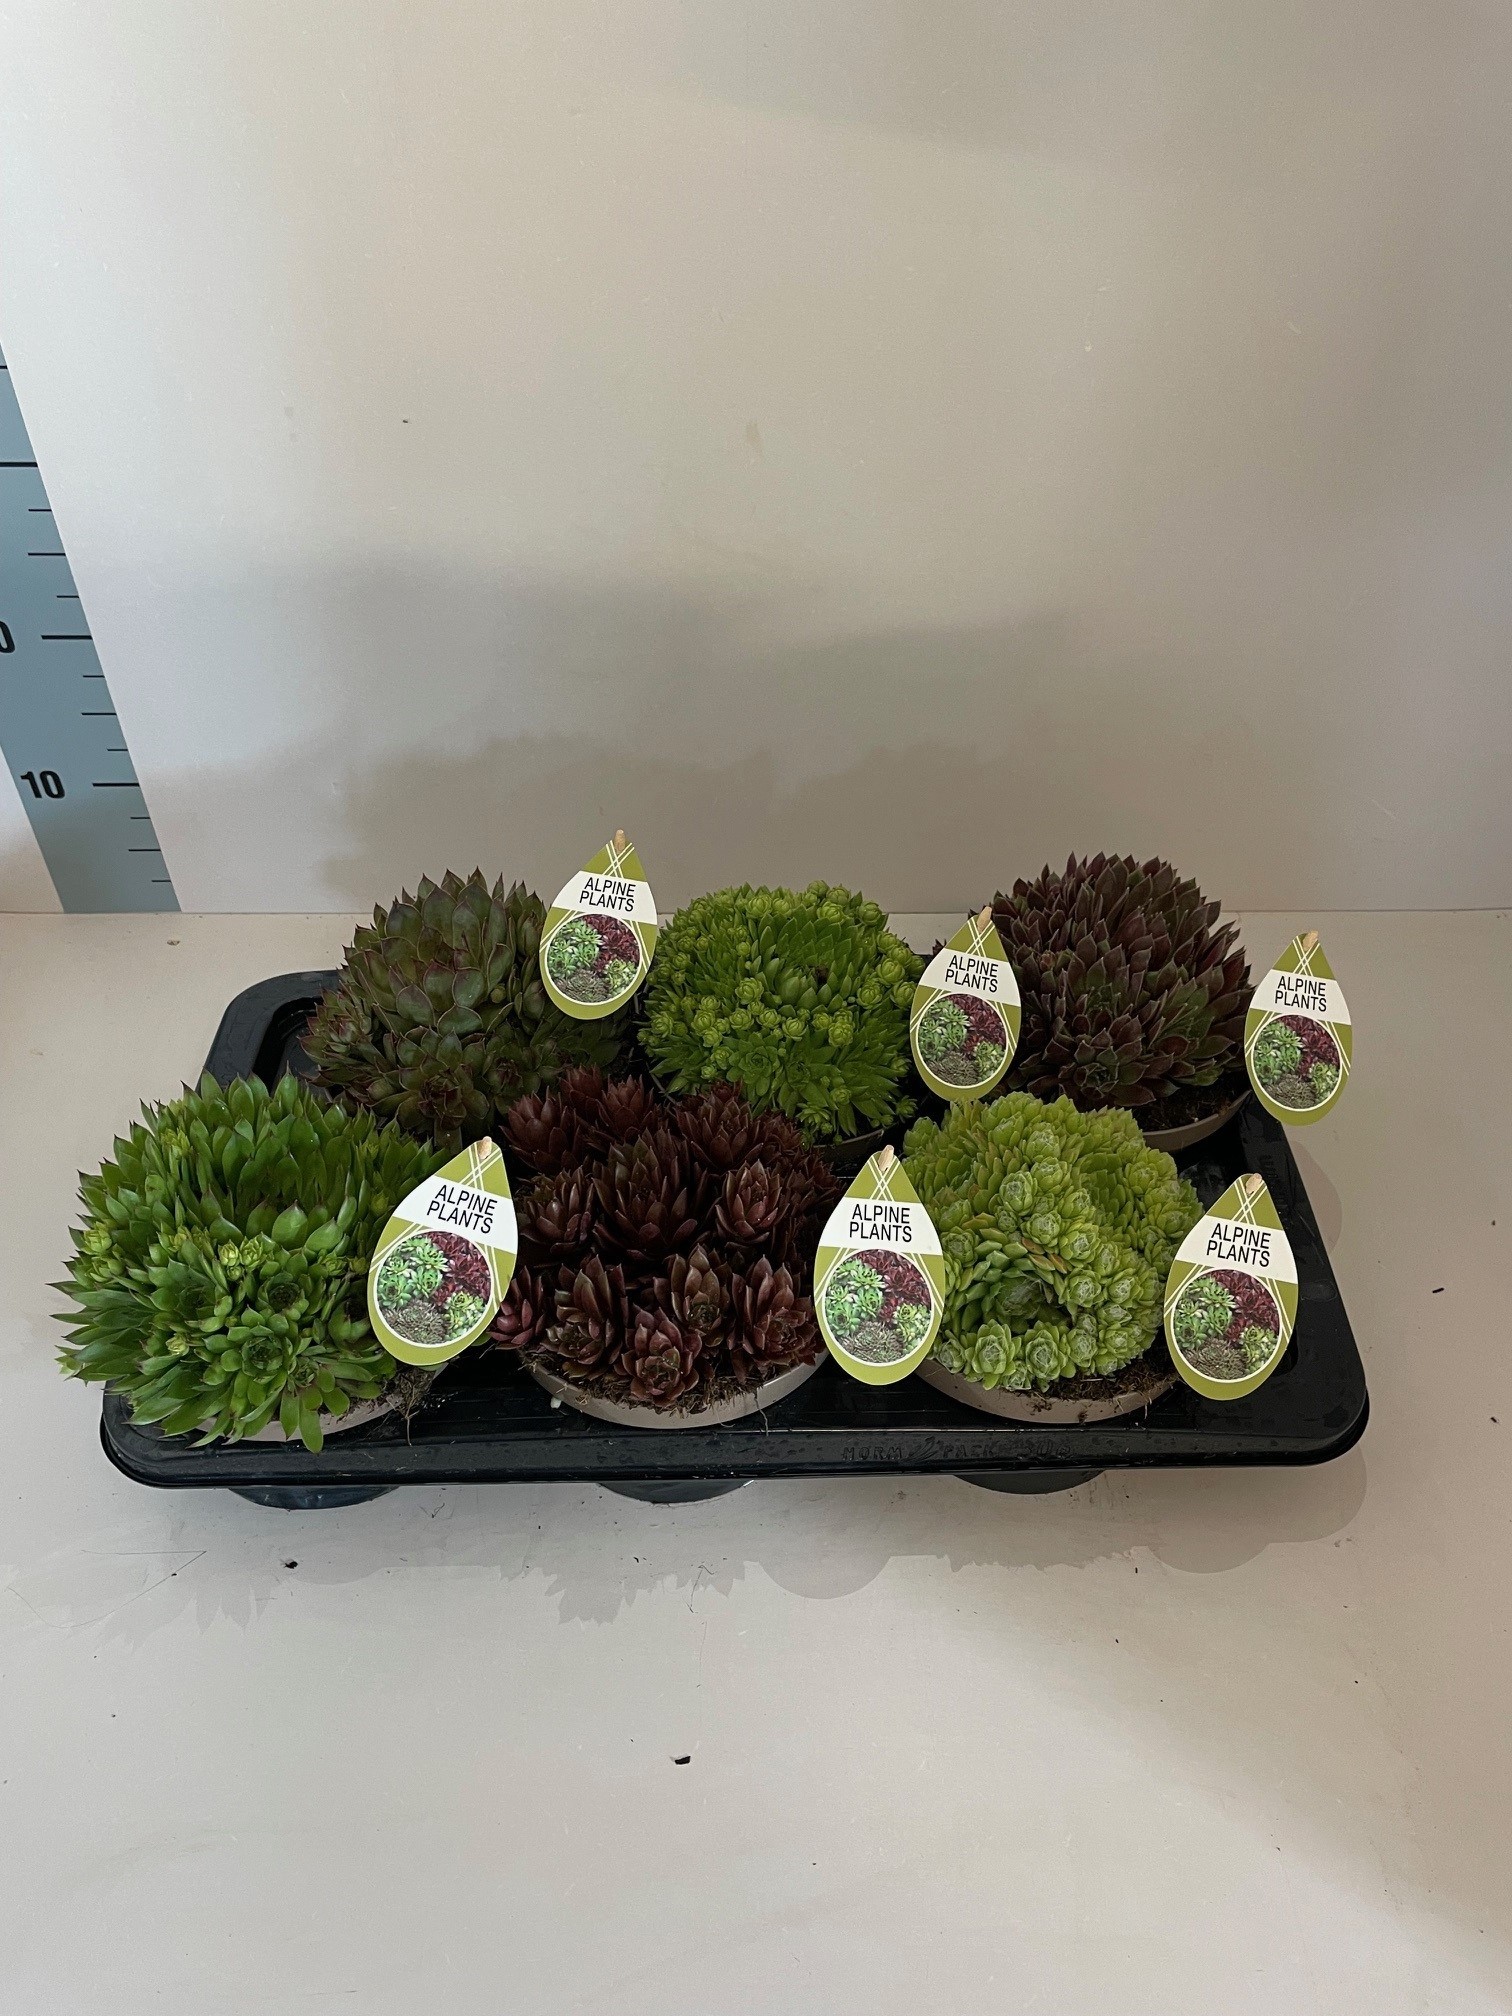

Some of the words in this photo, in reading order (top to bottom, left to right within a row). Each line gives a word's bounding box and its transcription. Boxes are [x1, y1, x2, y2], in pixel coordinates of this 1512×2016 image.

[20, 770, 66, 799] 10
[584, 876, 637, 898] ALPINE
[579, 890, 635, 912] PLANTS
[948, 954, 999, 978] ALPINE
[945, 968, 998, 993] PLANTS
[1277, 975, 1327, 997] ALPINE
[1274, 989, 1327, 1012] PLANTS
[434, 1184, 498, 1217] ALPINE
[426, 1200, 493, 1234] PLANTS
[851, 1203, 911, 1224] ALPINE
[849, 1221, 912, 1243] PLANTS
[1210, 1222, 1272, 1250] ALPINE
[1206, 1239, 1270, 1268] PLANTS
